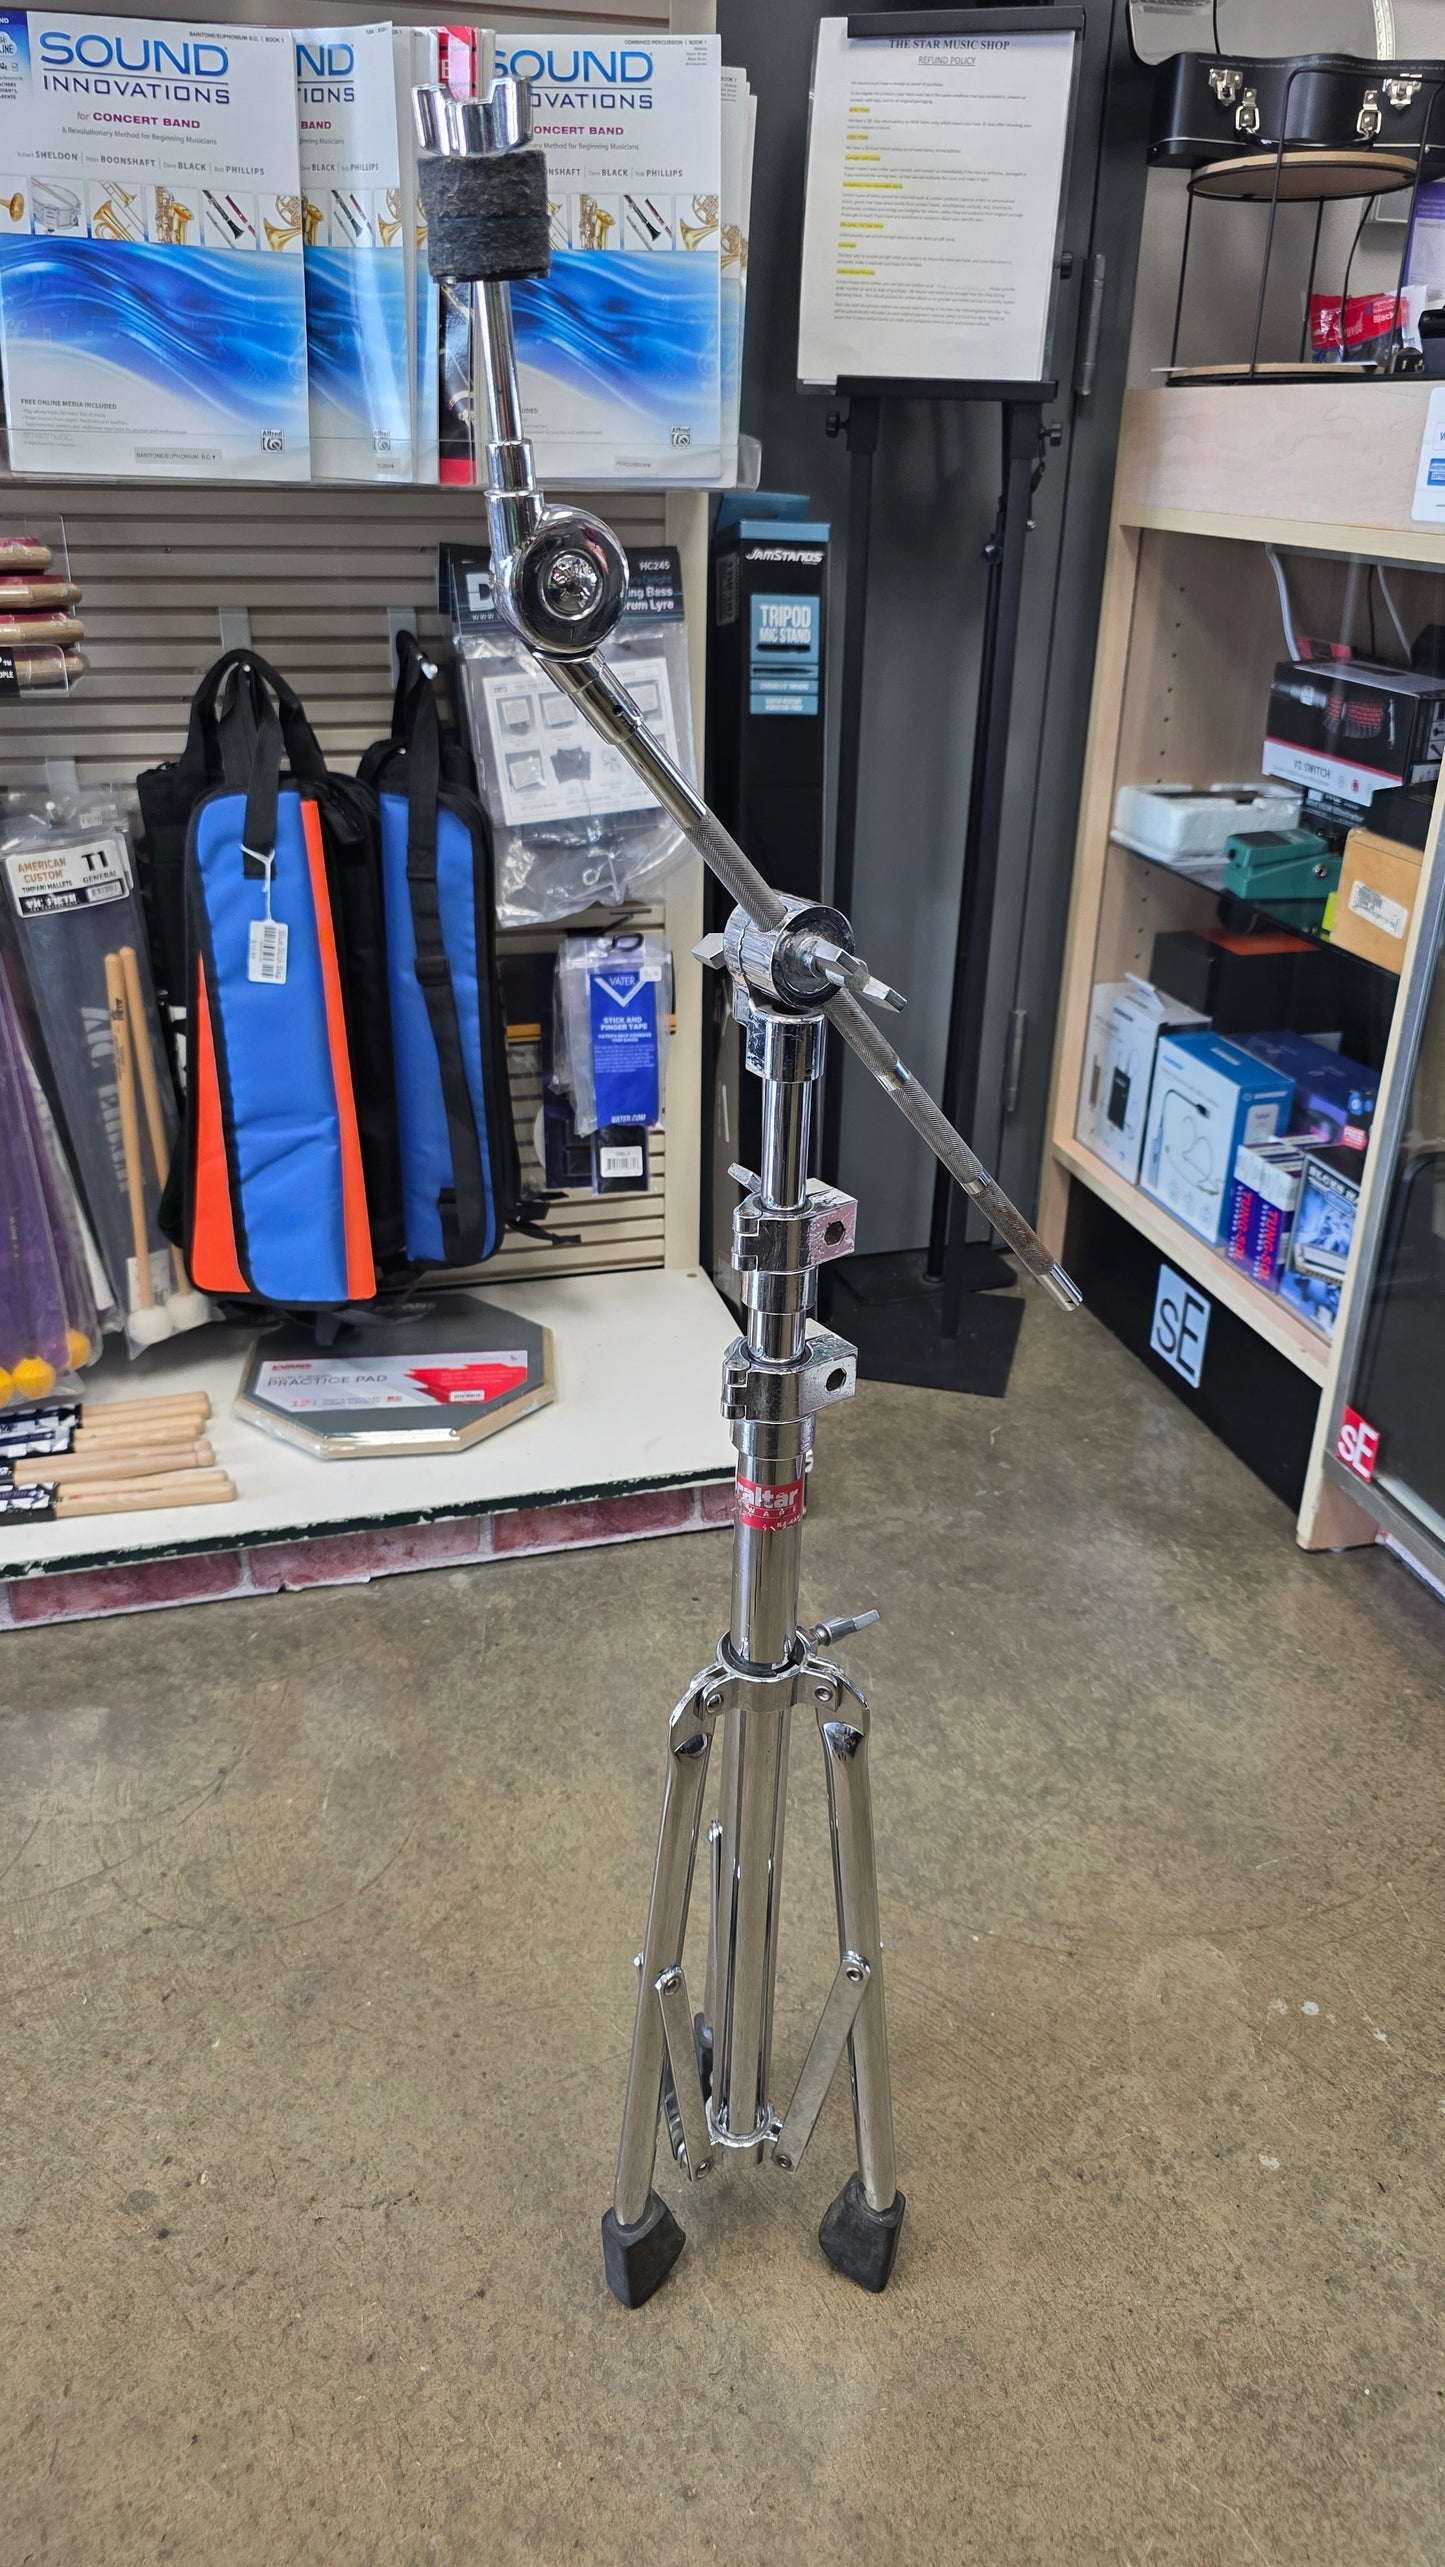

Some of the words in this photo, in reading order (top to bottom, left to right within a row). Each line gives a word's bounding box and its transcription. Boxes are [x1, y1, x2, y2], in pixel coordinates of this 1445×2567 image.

[889, 39, 911, 49] THE
[912, 39, 941, 49] STAR
[943, 39, 979, 50] MUSIC
[981, 40, 1010, 51] SHOP
[40, 31, 229, 76] SOUND
[918, 56, 949, 65] REFUND
[950, 56, 977, 66] POLICY
[43, 75, 230, 105] INNOVATIONS
[297, 86, 355, 104] IONS
[77, 112, 90, 121] for
[93, 112, 159, 126] CONCERT
[163, 117, 200, 129] BAND
[300, 120, 332, 130] BAND
[68, 127, 113, 139] Revolutionary
[114, 130, 141, 140] Method
[151, 133, 185, 144] Beginning
[186, 135, 217, 146] Musicians
[589, 126, 625, 136] BAND
[543, 142, 568, 150] Method
[578, 142, 609, 151] Beginning
[610, 143, 640, 151] Musicians
[35, 150, 78, 161] SHELDON
[100, 155, 156, 167] BOONSHAFT
[178, 161, 207, 172] BLACK
[226, 166, 265, 176] PHILLIPS
[311, 163, 336, 172] BLACK
[350, 163, 380, 171] PHILLIPS
[601, 169, 629, 177] BLACK
[646, 168, 684, 178] PHILLIPS
[262, 429, 282, 438] Alfred
[671, 426, 691, 434] Alfred
[646, 585, 673, 598] Bass
[649, 598, 675, 612] Lyre
[759, 604, 811, 628] TRIPOD
[759, 628, 778, 643] MIC
[779, 628, 811, 644] STAND
[18, 857, 67, 873] AMERICAN
[81, 850, 109, 872] T1
[23, 870, 63, 884] CUSTOM
[82, 870, 118, 884] GENERAL
[22, 884, 47, 894] TIMPANI
[47, 880, 73, 889] MALLETS
[609, 975, 636, 986] VATER
[600, 1024, 627, 1032] FINGER
[629, 1022, 648, 1031] TAPE
[603, 1017, 625, 1025] STICK
[611, 1113, 646, 1124] VATER.COM
[1233, 1191, 1254, 1261] TUNG-SOL
[1258, 1210, 1280, 1281] TUNG-SOL
[268, 1375, 350, 1387] PRACTICE
[355, 1374, 388, 1384] PAD
